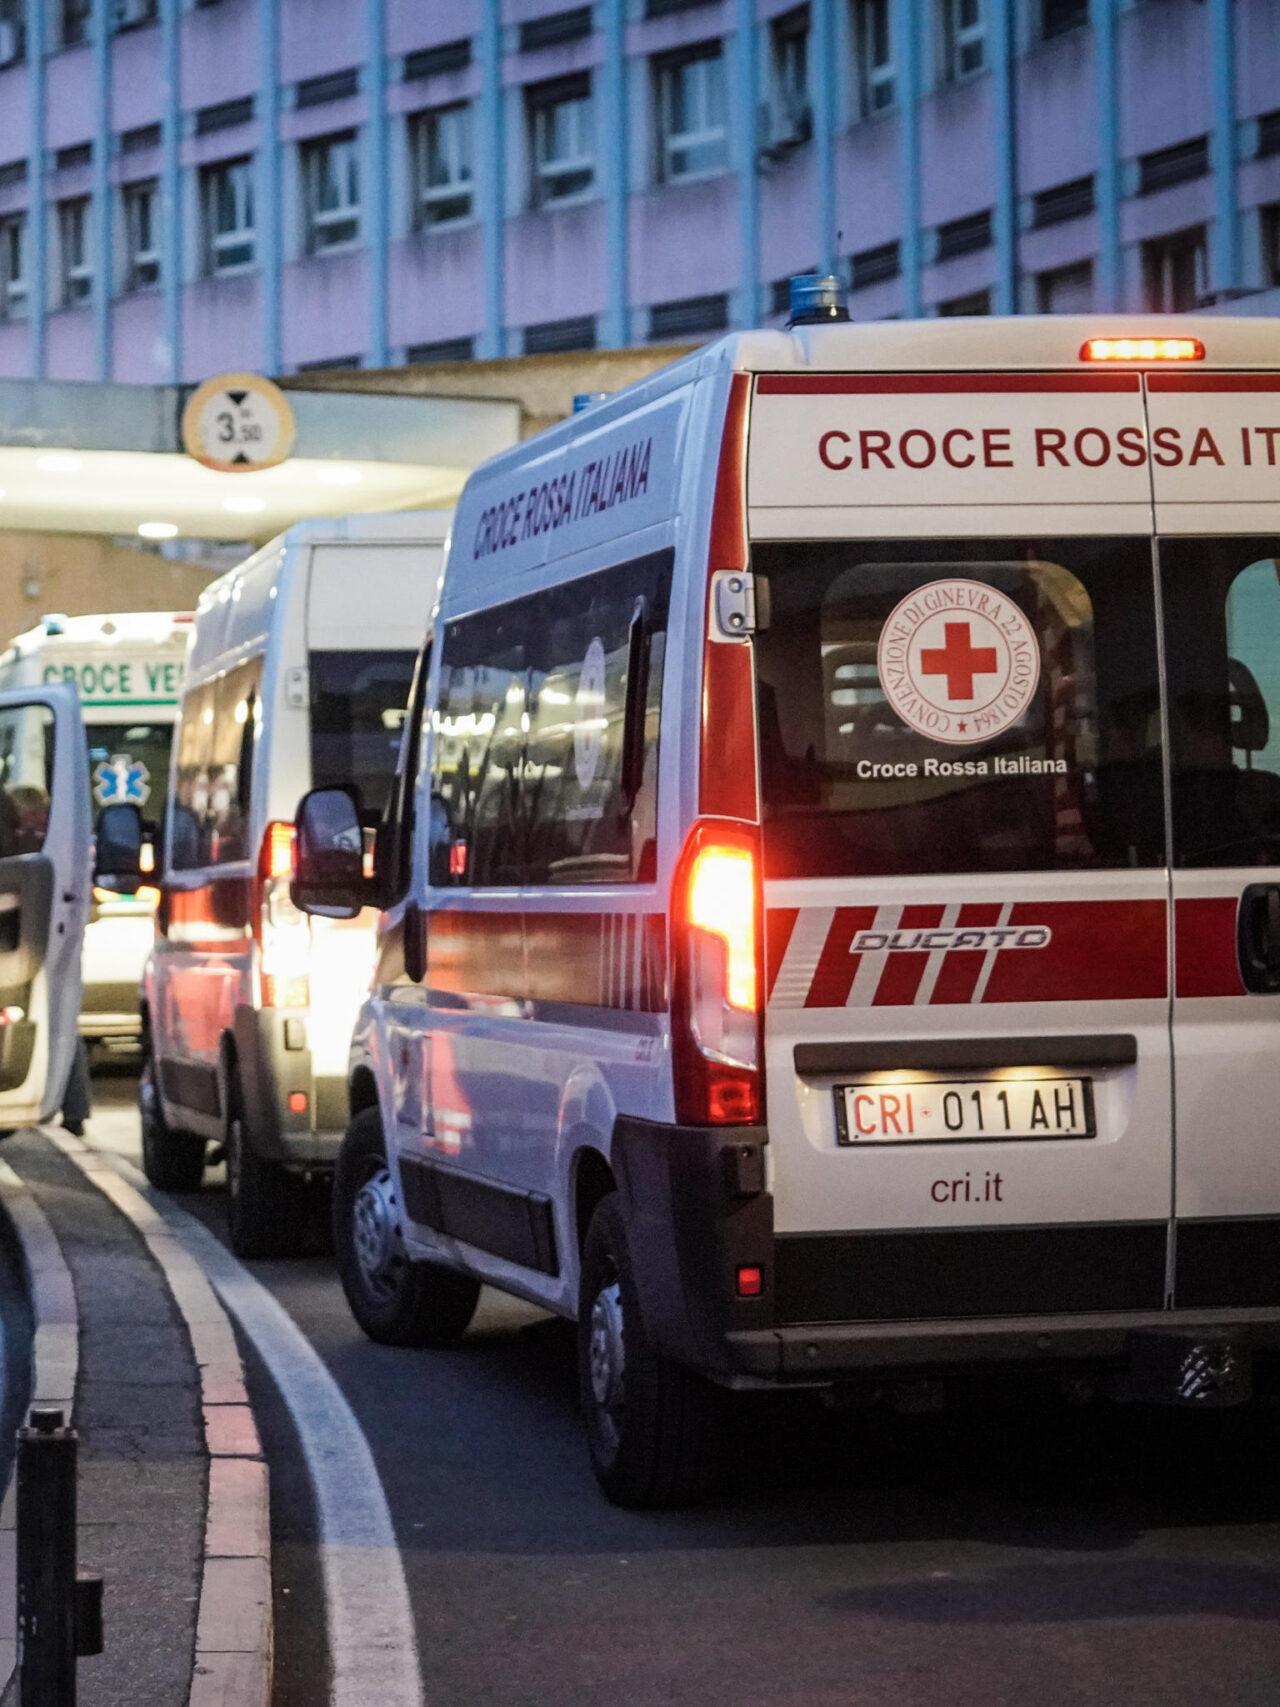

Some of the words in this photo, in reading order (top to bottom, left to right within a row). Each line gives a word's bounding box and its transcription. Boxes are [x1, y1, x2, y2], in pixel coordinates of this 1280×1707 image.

[818, 428, 1014, 471] CROCE
[1033, 426, 1225, 468] ROSSA
[473, 491, 526, 560] CROCE
[520, 470, 576, 541] ROSSA
[573, 436, 653, 522] ITALIANA
[904, 603, 926, 624] DI
[924, 587, 1002, 621] GINEVRA
[1001, 615, 1023, 636] 22
[42, 662, 131, 694] CROCE
[886, 621, 951, 733] CONVENZIONE
[1007, 640, 1032, 711] AGOSTO
[974, 702, 1007, 733] 1864
[857, 759, 918, 778] Croce
[924, 758, 988, 776] Rossa
[994, 756, 1067, 775] Italiana
[853, 930, 1049, 950] DUCATO
[854, 1092, 914, 1135] CRI
[942, 1090, 1011, 1131] 011
[1030, 1087, 1077, 1129] AH
[930, 1171, 1003, 1202] cri.it
